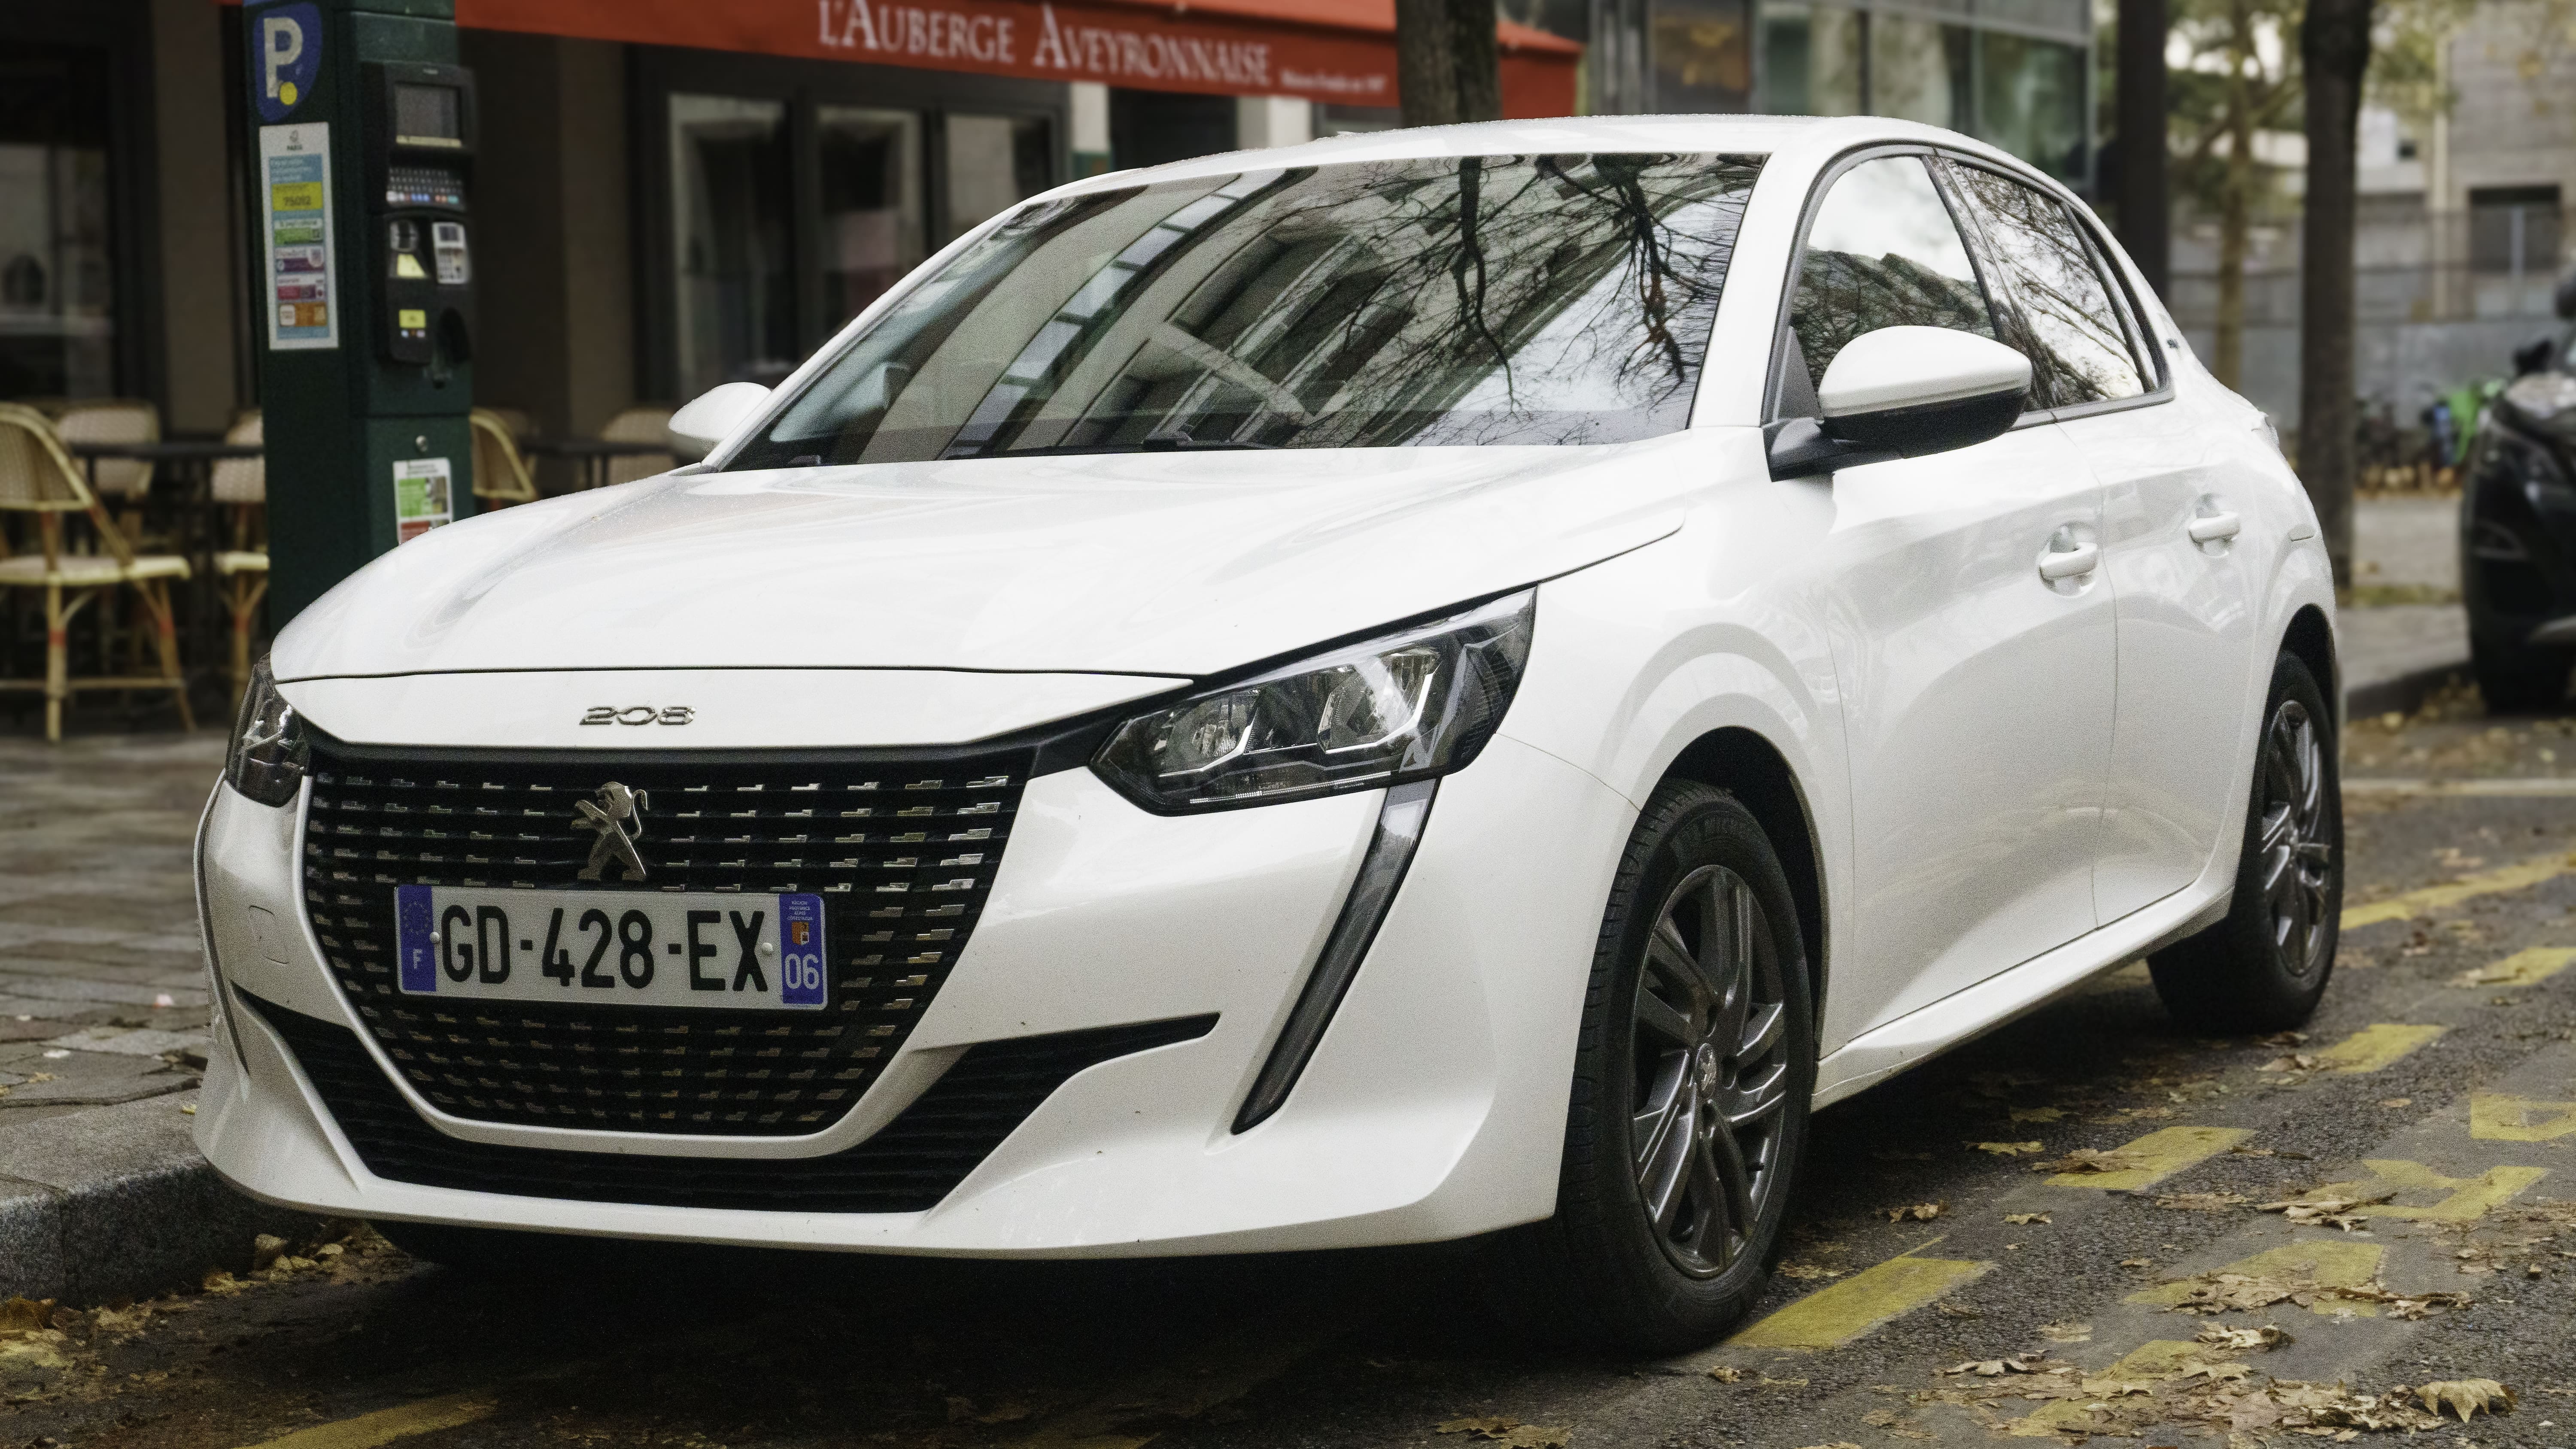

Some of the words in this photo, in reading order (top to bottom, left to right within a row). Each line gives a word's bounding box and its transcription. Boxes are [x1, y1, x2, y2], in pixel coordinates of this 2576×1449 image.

[263, 17, 303, 98] P
[579, 705, 696, 725] 208
[413, 949, 423, 969] F
[440, 904, 769, 992] GD-428-EX
[785, 953, 820, 990] 06
